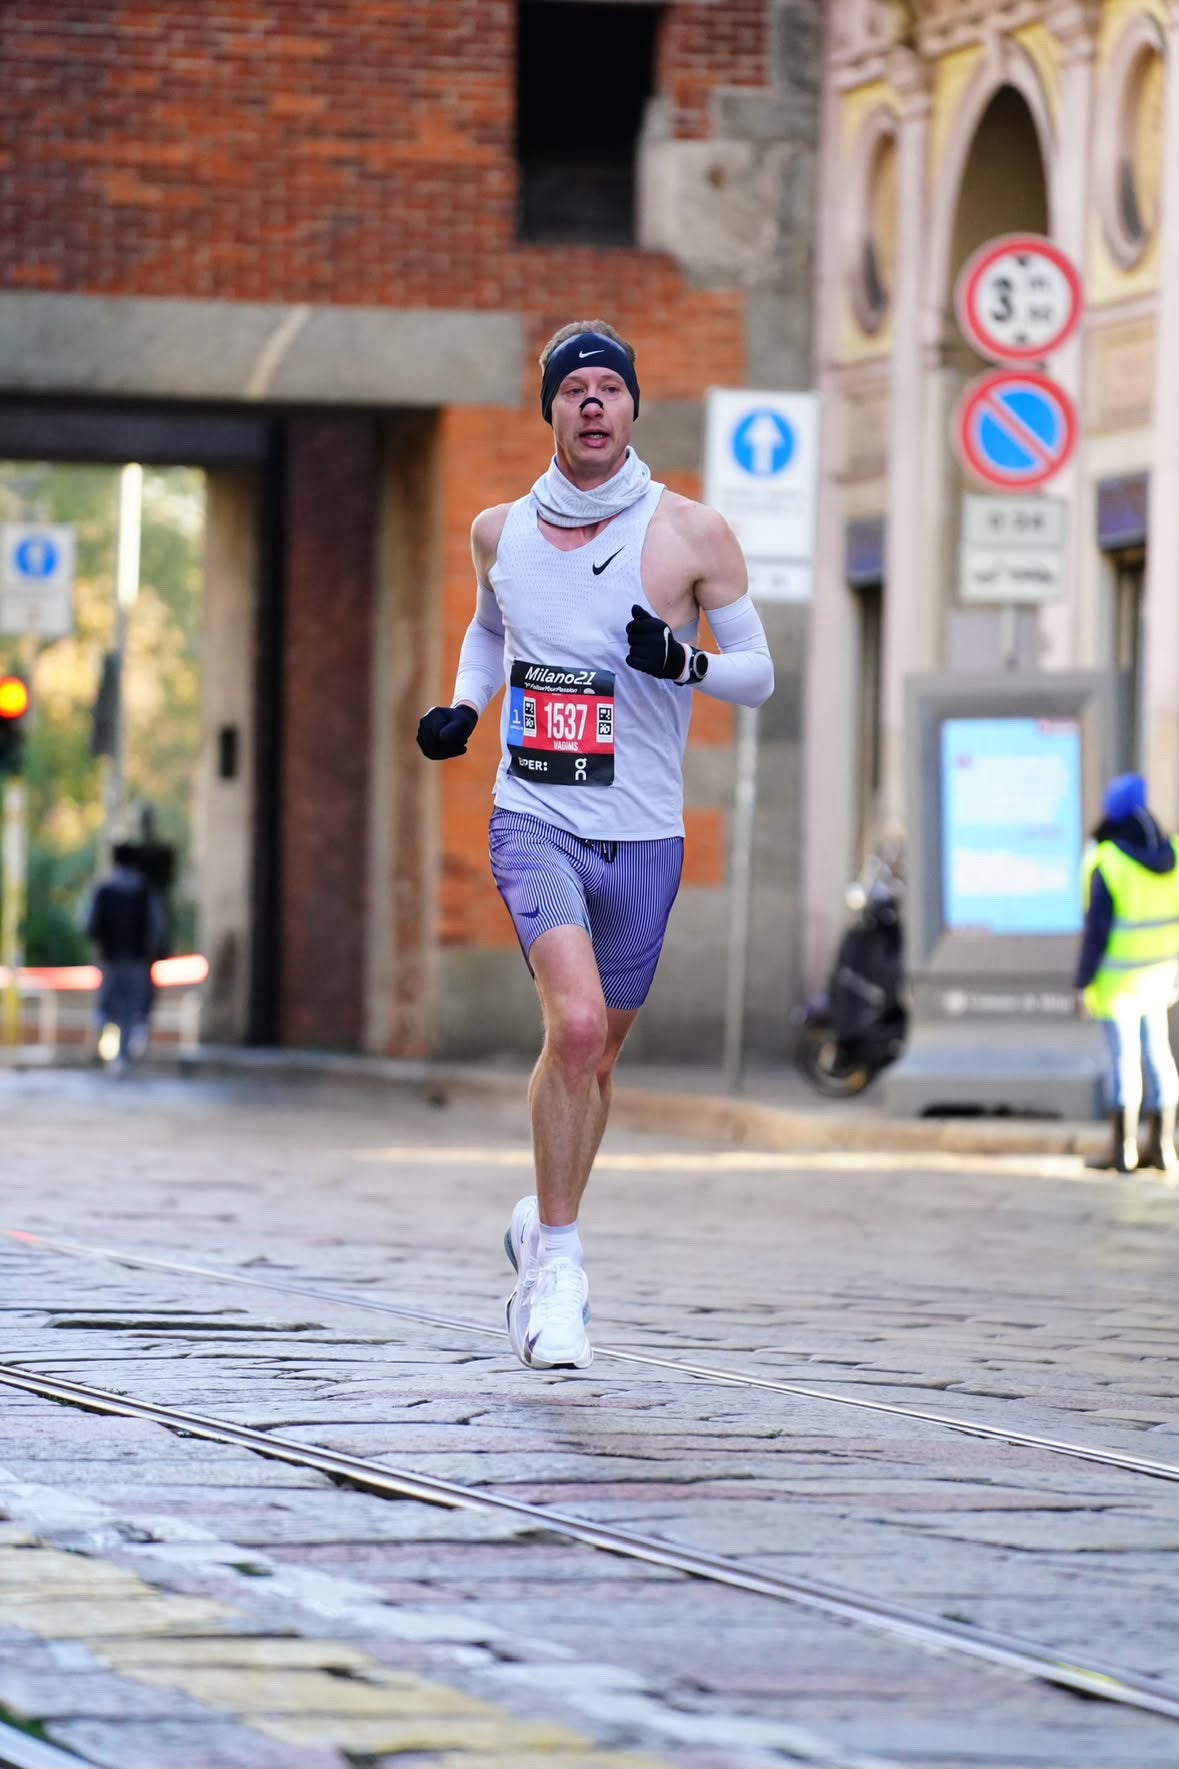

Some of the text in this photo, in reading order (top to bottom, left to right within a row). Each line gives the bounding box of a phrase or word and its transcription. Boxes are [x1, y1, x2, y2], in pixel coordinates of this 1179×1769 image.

[524, 666, 597, 686] Milano21
[512, 709, 521, 724] 1
[543, 701, 588, 740] 1537
[553, 741, 579, 752] VADIMS
